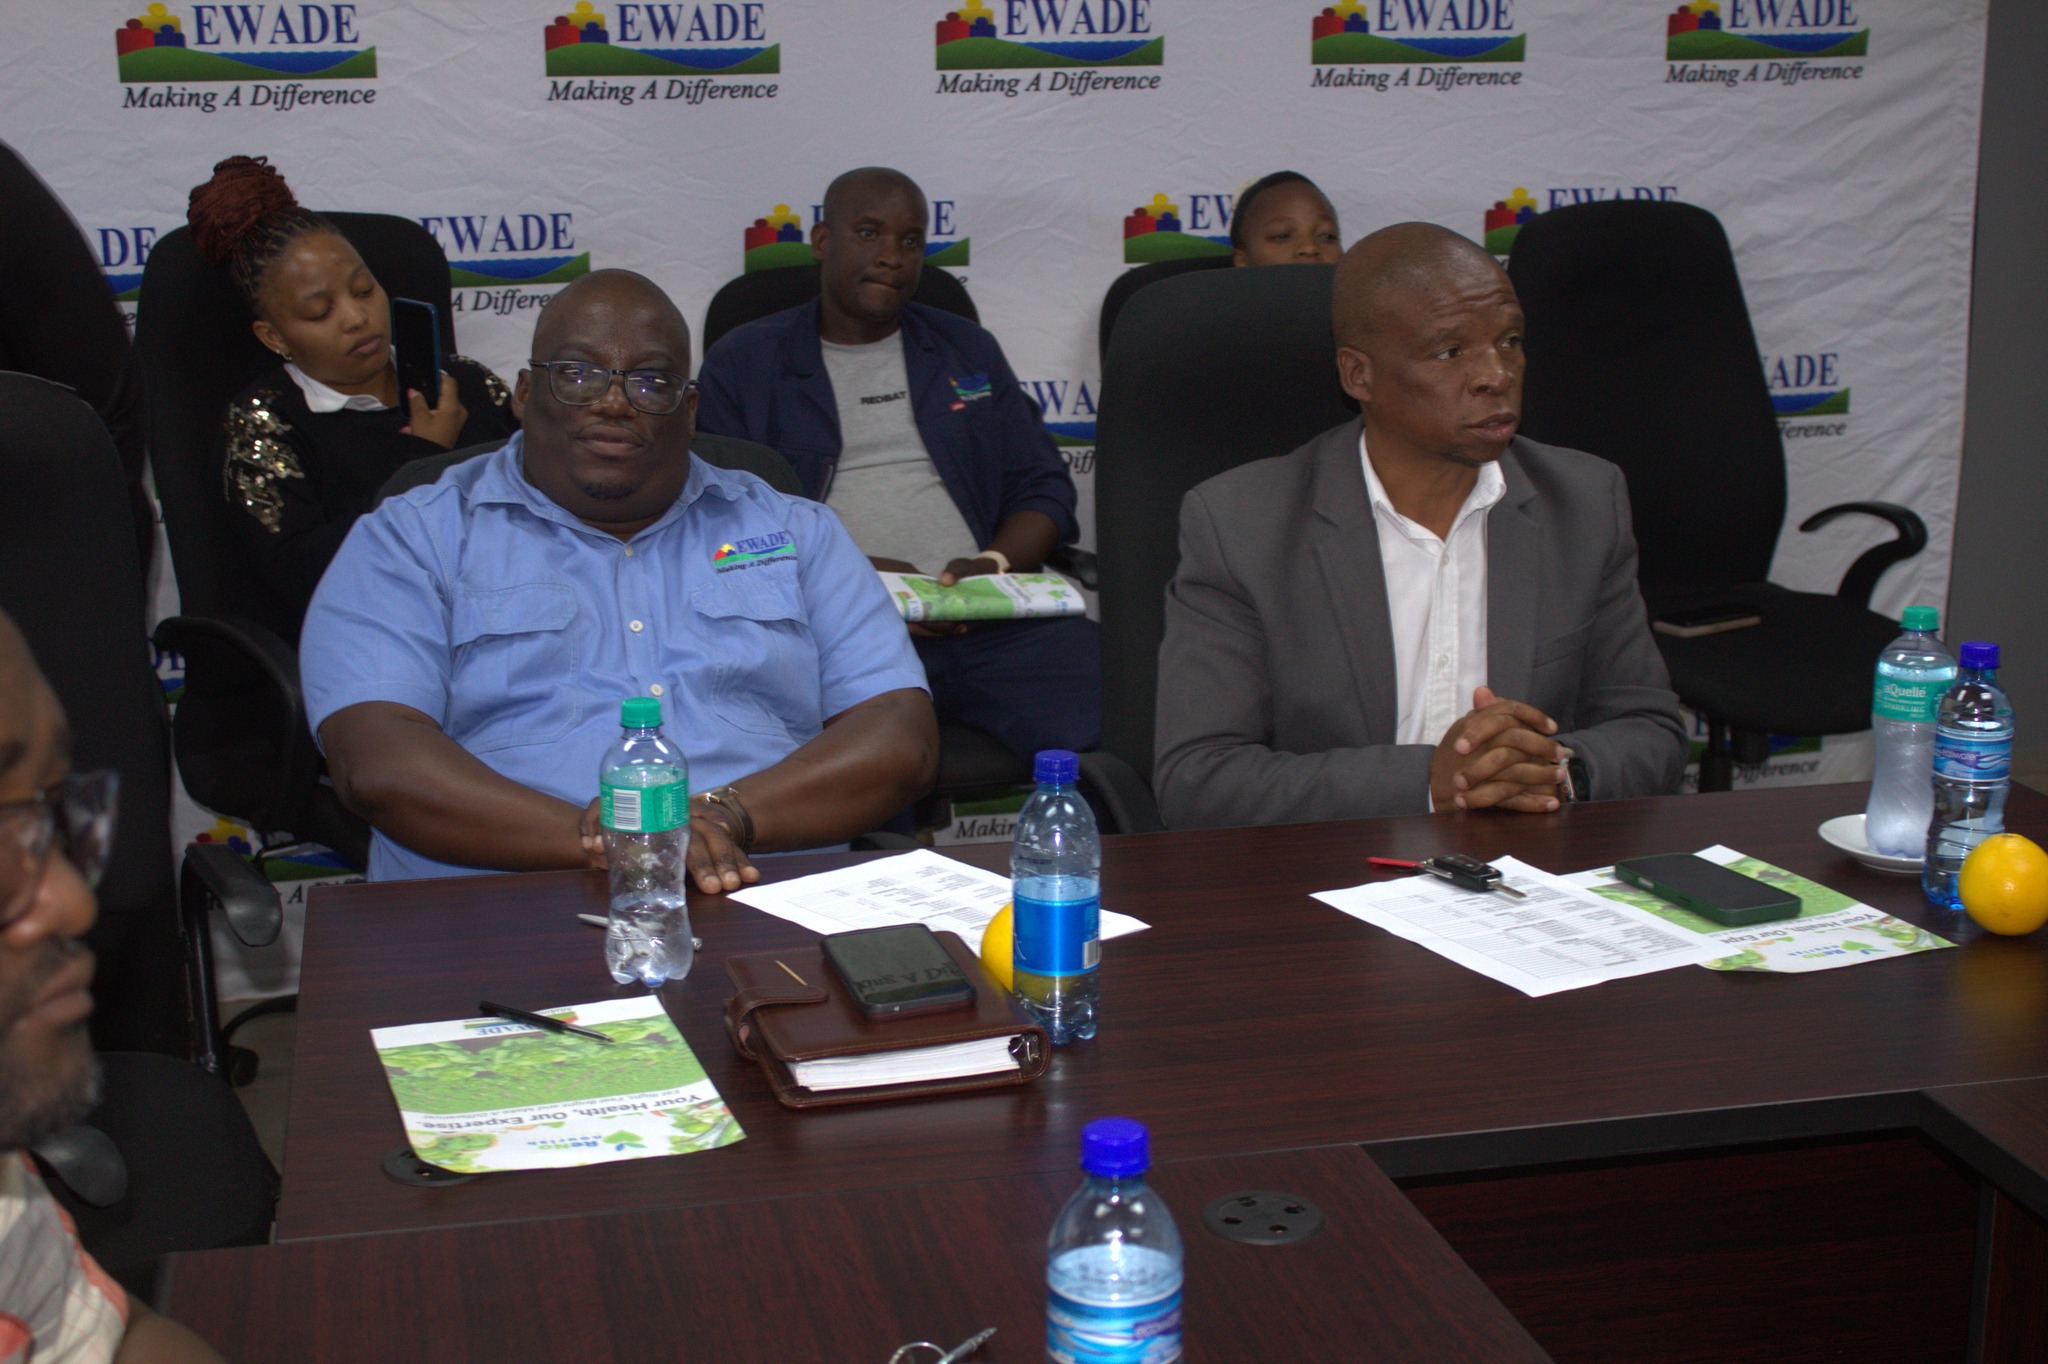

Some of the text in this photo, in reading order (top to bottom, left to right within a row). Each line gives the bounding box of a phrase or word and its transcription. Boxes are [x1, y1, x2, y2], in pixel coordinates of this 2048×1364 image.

[192, 4, 360, 45] EWADE
[617, 3, 766, 42] EWADE
[1004, 0, 1152, 35] EWADE
[1377, 0, 1514, 31] EWADE
[1729, 0, 1858, 28] EWADE
[936, 71, 1161, 97] Making A Difference
[1311, 66, 1522, 91] Making A Difference
[1665, 61, 1864, 87] Making A Difference
[122, 84, 376, 112] Making A Difference
[547, 78, 778, 104] Making A Difference
[451, 289, 553, 315] A Differe
[1762, 353, 1840, 388] ADE
[735, 531, 790, 553] EWADE
[955, 817, 1016, 839] Maki
[417, 1093, 702, 1131] Your Health, Our Expertise.
